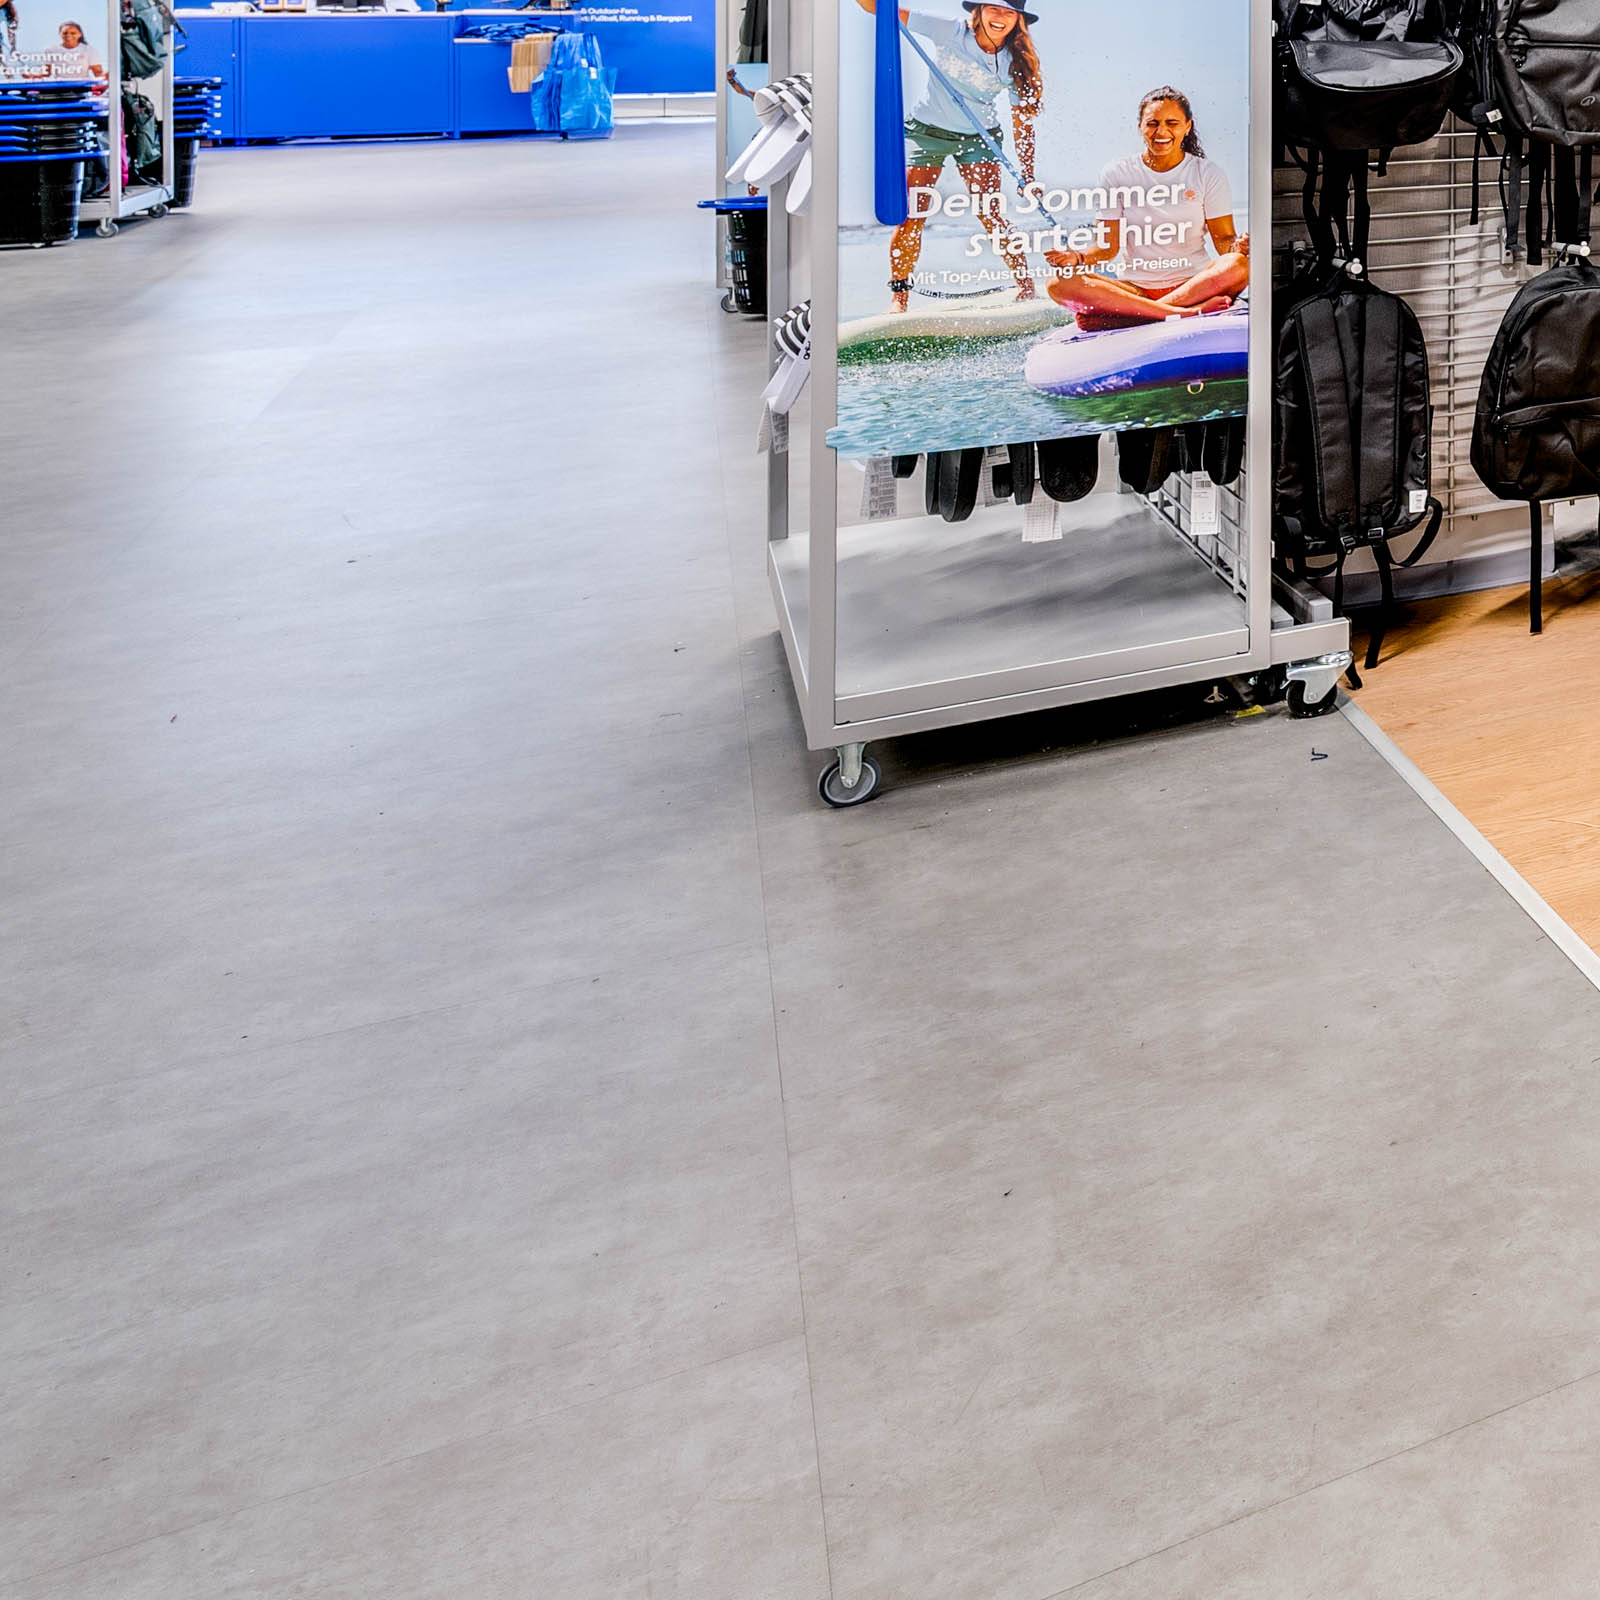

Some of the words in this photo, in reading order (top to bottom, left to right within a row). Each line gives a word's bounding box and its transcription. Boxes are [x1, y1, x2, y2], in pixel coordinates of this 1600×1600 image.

[907, 184, 1010, 220] Dein
[1017, 181, 1186, 214] Sommer
[965, 220, 1111, 257] startet
[1120, 218, 1191, 248] hier
[908, 271, 937, 287] Mit
[939, 264, 1074, 285] Top-Ausrüstung
[1076, 262, 1095, 275] zu
[1100, 256, 1192, 275] Top-Preisen.
